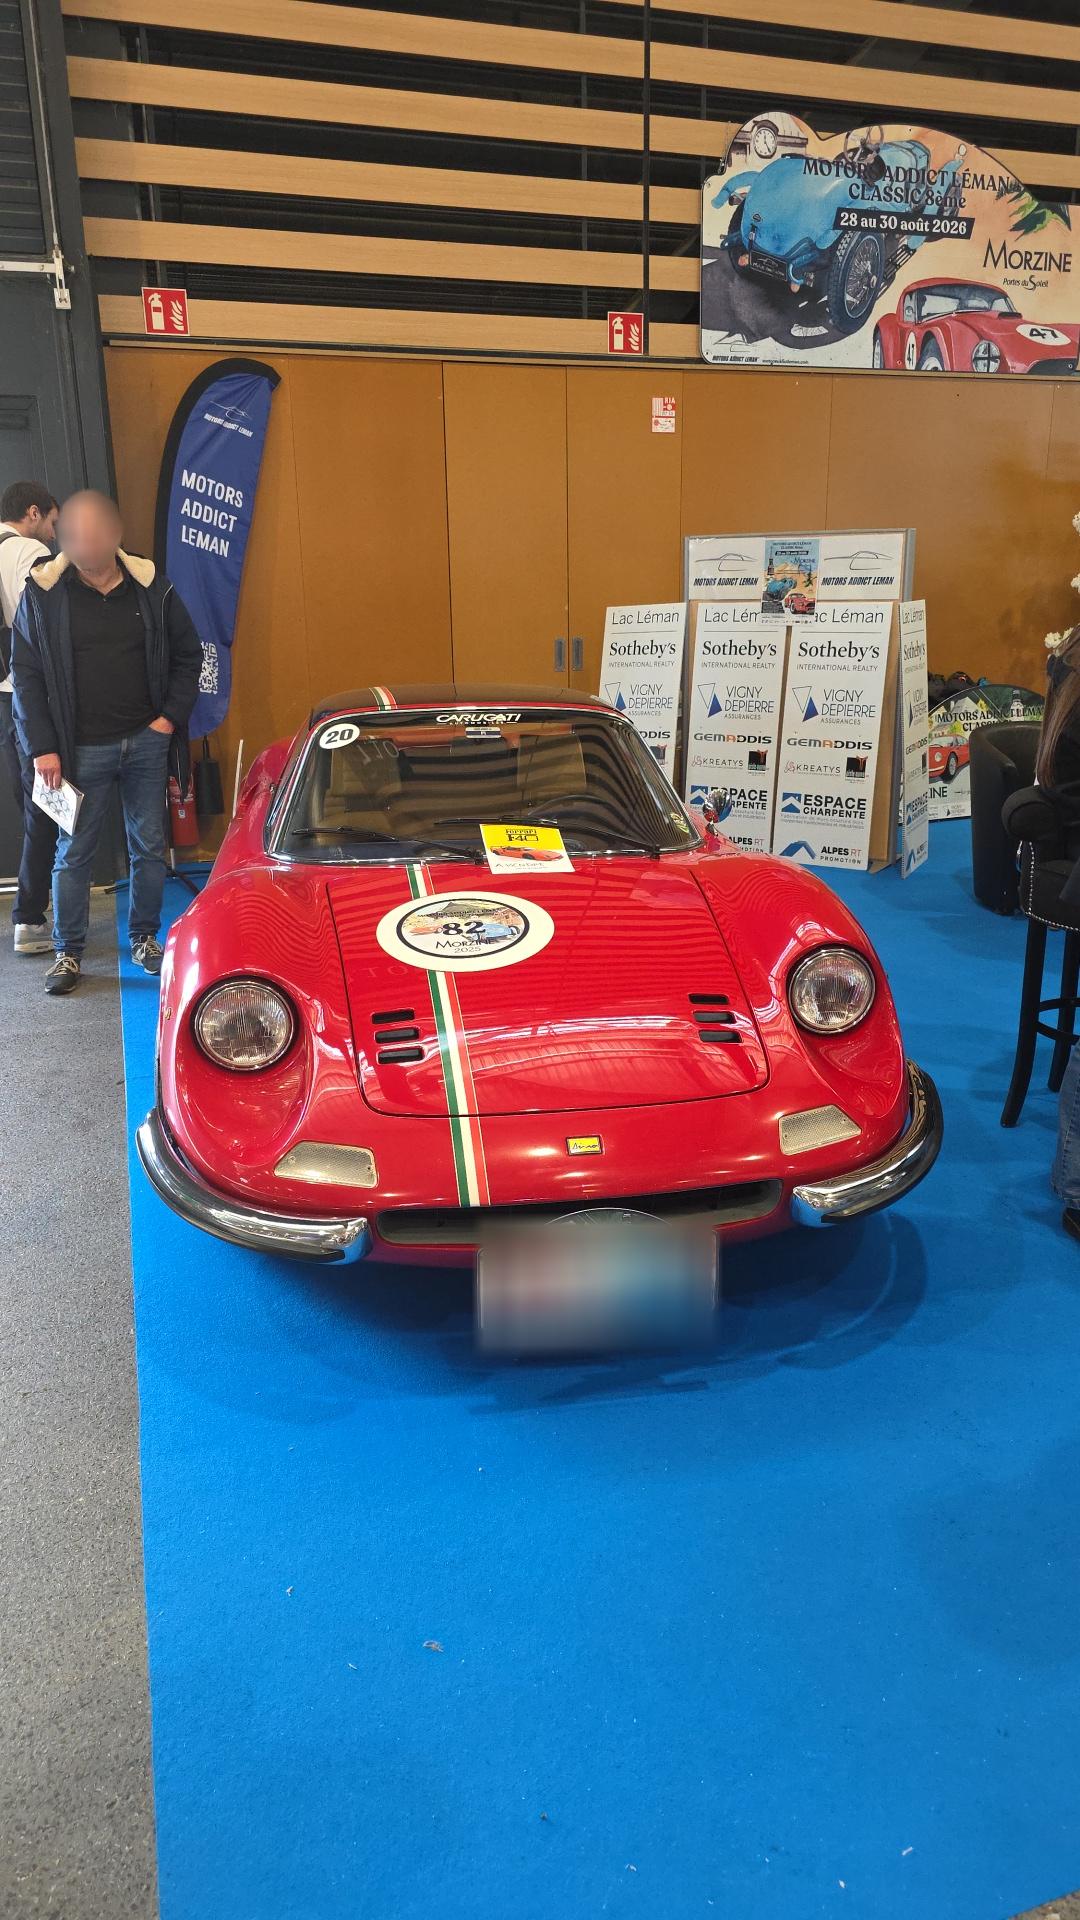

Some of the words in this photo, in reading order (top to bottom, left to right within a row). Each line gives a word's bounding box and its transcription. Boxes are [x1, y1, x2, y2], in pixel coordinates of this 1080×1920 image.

[803, 159, 880, 182] MOTOR
[883, 167, 948, 187] ADDICT
[951, 168, 1010, 193] LÉMAN
[848, 182, 920, 205] CLASSIC
[925, 189, 966, 208] 8ème
[840, 212, 857, 227] 28
[860, 217, 877, 229] au
[880, 215, 897, 230] 30
[900, 217, 930, 233] août
[932, 219, 967, 235] 2026
[983, 238, 1072, 273] MORZINE
[1003, 278, 1021, 288] Portes
[1021, 278, 1029, 287] du
[1029, 327, 1060, 339] 47
[181, 469, 243, 508] MOTORS
[181, 498, 237, 532] ADDICT
[181, 525, 229, 558] LEMAN
[693, 578, 716, 586] MOTORS
[718, 578, 738, 586] ADDICT
[739, 577, 758, 586] LEMAN
[821, 577, 847, 586] MOTORS
[848, 577, 871, 585] ADDICT
[872, 577, 894, 585] LEMAN
[612, 612, 633, 625] Lac
[637, 609, 680, 624] Léman
[704, 609, 728, 623] Lac
[733, 609, 760, 623] Lém
[832, 609, 884, 623] Léman
[609, 640, 676, 658] Sotheby's
[702, 640, 777, 659] Sotheby's
[798, 641, 880, 662] Sotheby's
[653, 660, 675, 668] REALTY
[852, 664, 878, 672] REALTY
[630, 683, 663, 696] VIGNY
[726, 686, 763, 698] VIGNY
[823, 689, 863, 702] VIGNY
[628, 697, 673, 709] DEPIERRE
[724, 700, 775, 713] DEPIERRE
[821, 704, 876, 718] DEPIERRE
[937, 710, 978, 723] MOTORS
[436, 713, 521, 724] CARUGATI
[324, 728, 354, 744] 20
[639, 731, 671, 739] DDIS
[694, 733, 772, 744] GEMADDIS
[787, 738, 873, 750] GEMADDIS
[703, 759, 744, 767] KREATYS
[796, 765, 841, 773] KREATYS
[711, 787, 768, 802] PACE
[731, 801, 767, 810] RPENTE
[803, 794, 867, 810] ESPACE
[803, 807, 865, 819] CHARPENTE
[821, 846, 849, 856] ALPES
[851, 849, 862, 857] RT
[820, 856, 861, 864] PROMOTION
[442, 921, 486, 935] 82
[435, 938, 495, 949] MORZINE
[454, 946, 482, 954] 2025
